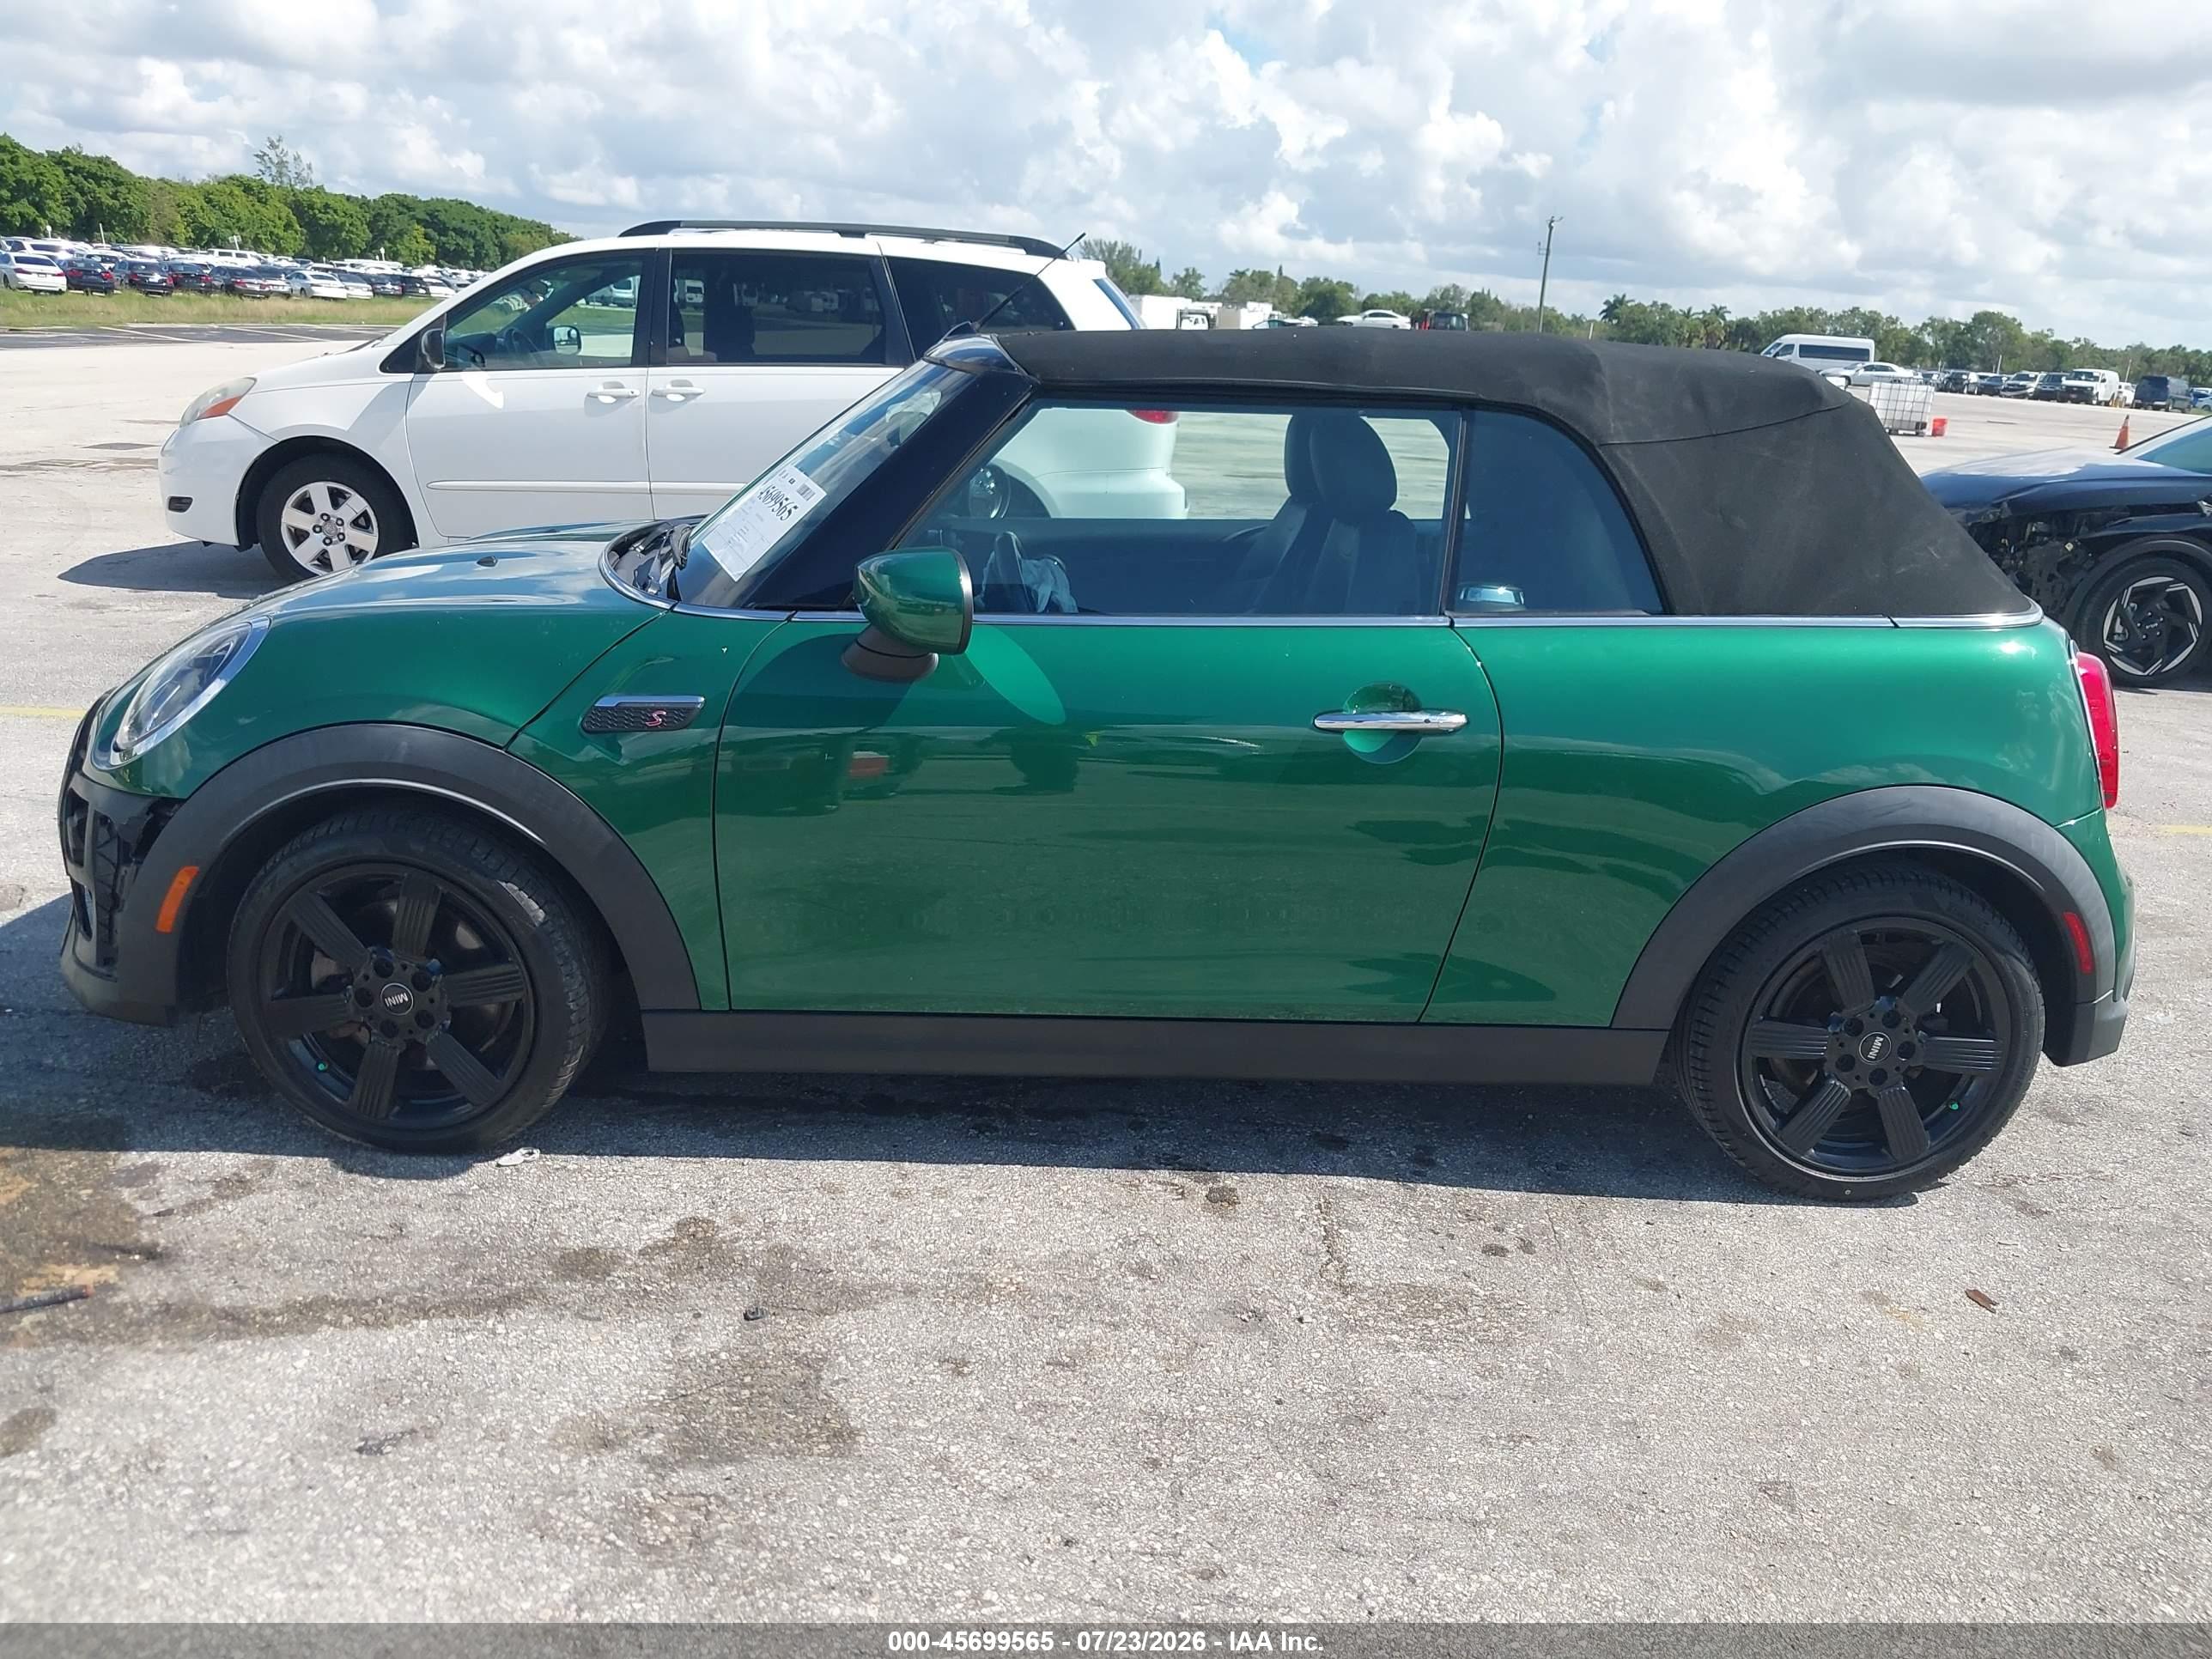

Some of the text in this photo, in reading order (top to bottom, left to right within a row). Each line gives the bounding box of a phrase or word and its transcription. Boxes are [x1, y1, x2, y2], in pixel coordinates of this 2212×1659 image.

[757, 484, 799, 521] 45699565
[645, 710, 666, 726] S
[384, 992, 409, 1007] MINI
[1867, 1036, 1884, 1060] MINI
